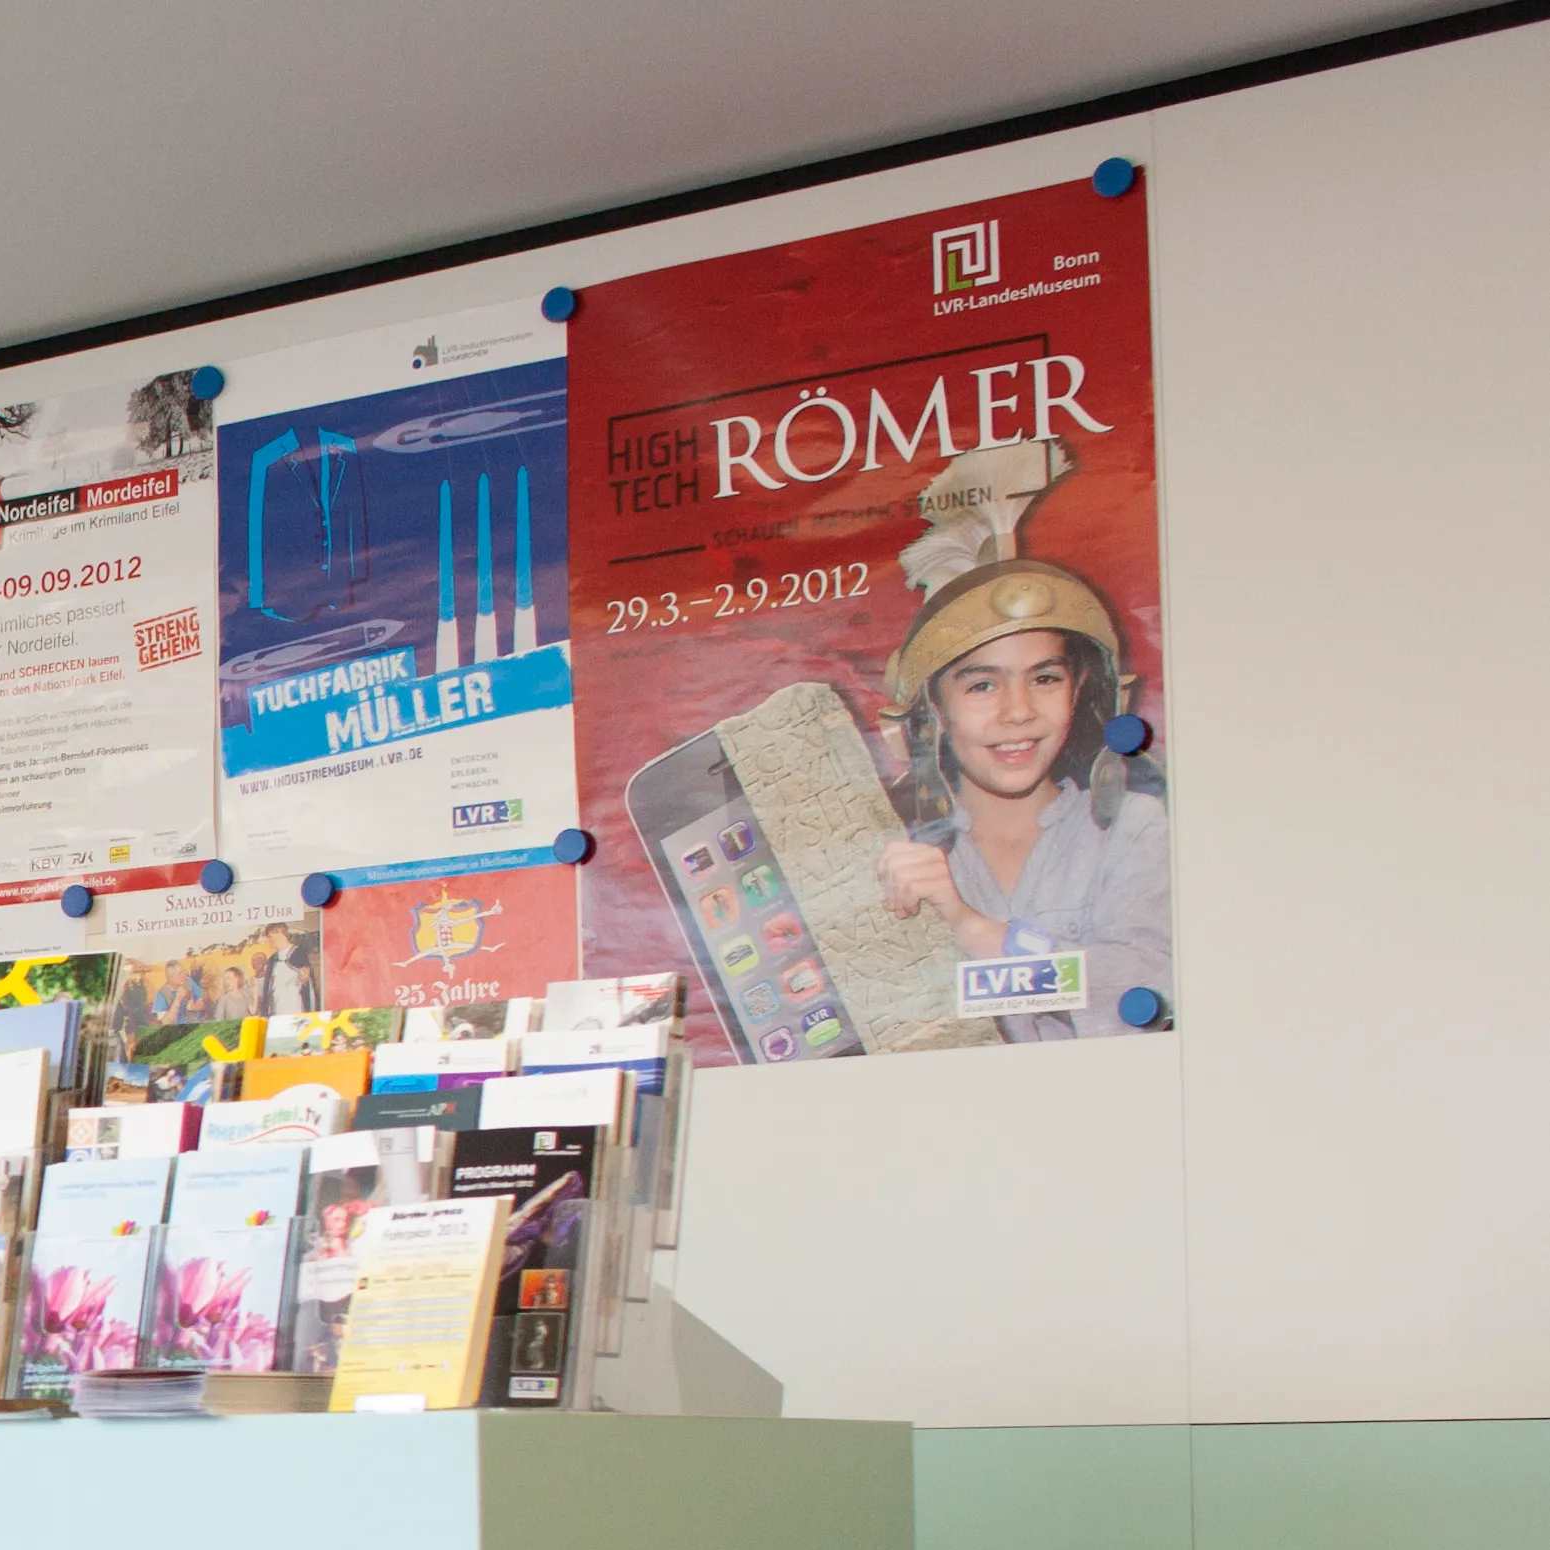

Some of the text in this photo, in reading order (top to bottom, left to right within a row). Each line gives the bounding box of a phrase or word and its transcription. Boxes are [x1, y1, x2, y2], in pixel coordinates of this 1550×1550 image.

[1053, 249, 1100, 271] Bonn
[933, 270, 1100, 316] LVR-LandesMuseum
[710, 353, 1113, 499] RÖMER
[610, 426, 697, 474] HIGH
[87, 476, 171, 508] Mordeifel
[610, 472, 699, 515] TECH
[71, 522, 85, 534] im
[89, 508, 148, 529] Krimiland
[152, 502, 180, 518] Eifel
[67, 599, 125, 626] passiert
[7, 631, 79, 656] Nordeifel.
[134, 612, 200, 647] STRENG
[19, 659, 84, 679] SCHRECKEN
[88, 654, 120, 669] lauern
[139, 636, 202, 666] GEHEIM
[13, 683, 30, 696] den
[33, 672, 97, 694] Nationalpark
[100, 668, 125, 682] Eifel.
[253, 651, 408, 716] TUCHFABRIK
[325, 671, 495, 754] MÜLLER
[240, 747, 423, 795] WWW.INDUSTRIEMUSEUM.LVR.DE
[455, 806, 496, 827] LVR
[115, 921, 133, 934] 15.
[202, 910, 233, 926] 2012
[247, 908, 262, 922] 17
[394, 979, 500, 1008] 25 Jahre
[967, 965, 1035, 998] LVR
[803, 1008, 829, 1025] LVR
[455, 1164, 536, 1181] PROGRAMM
